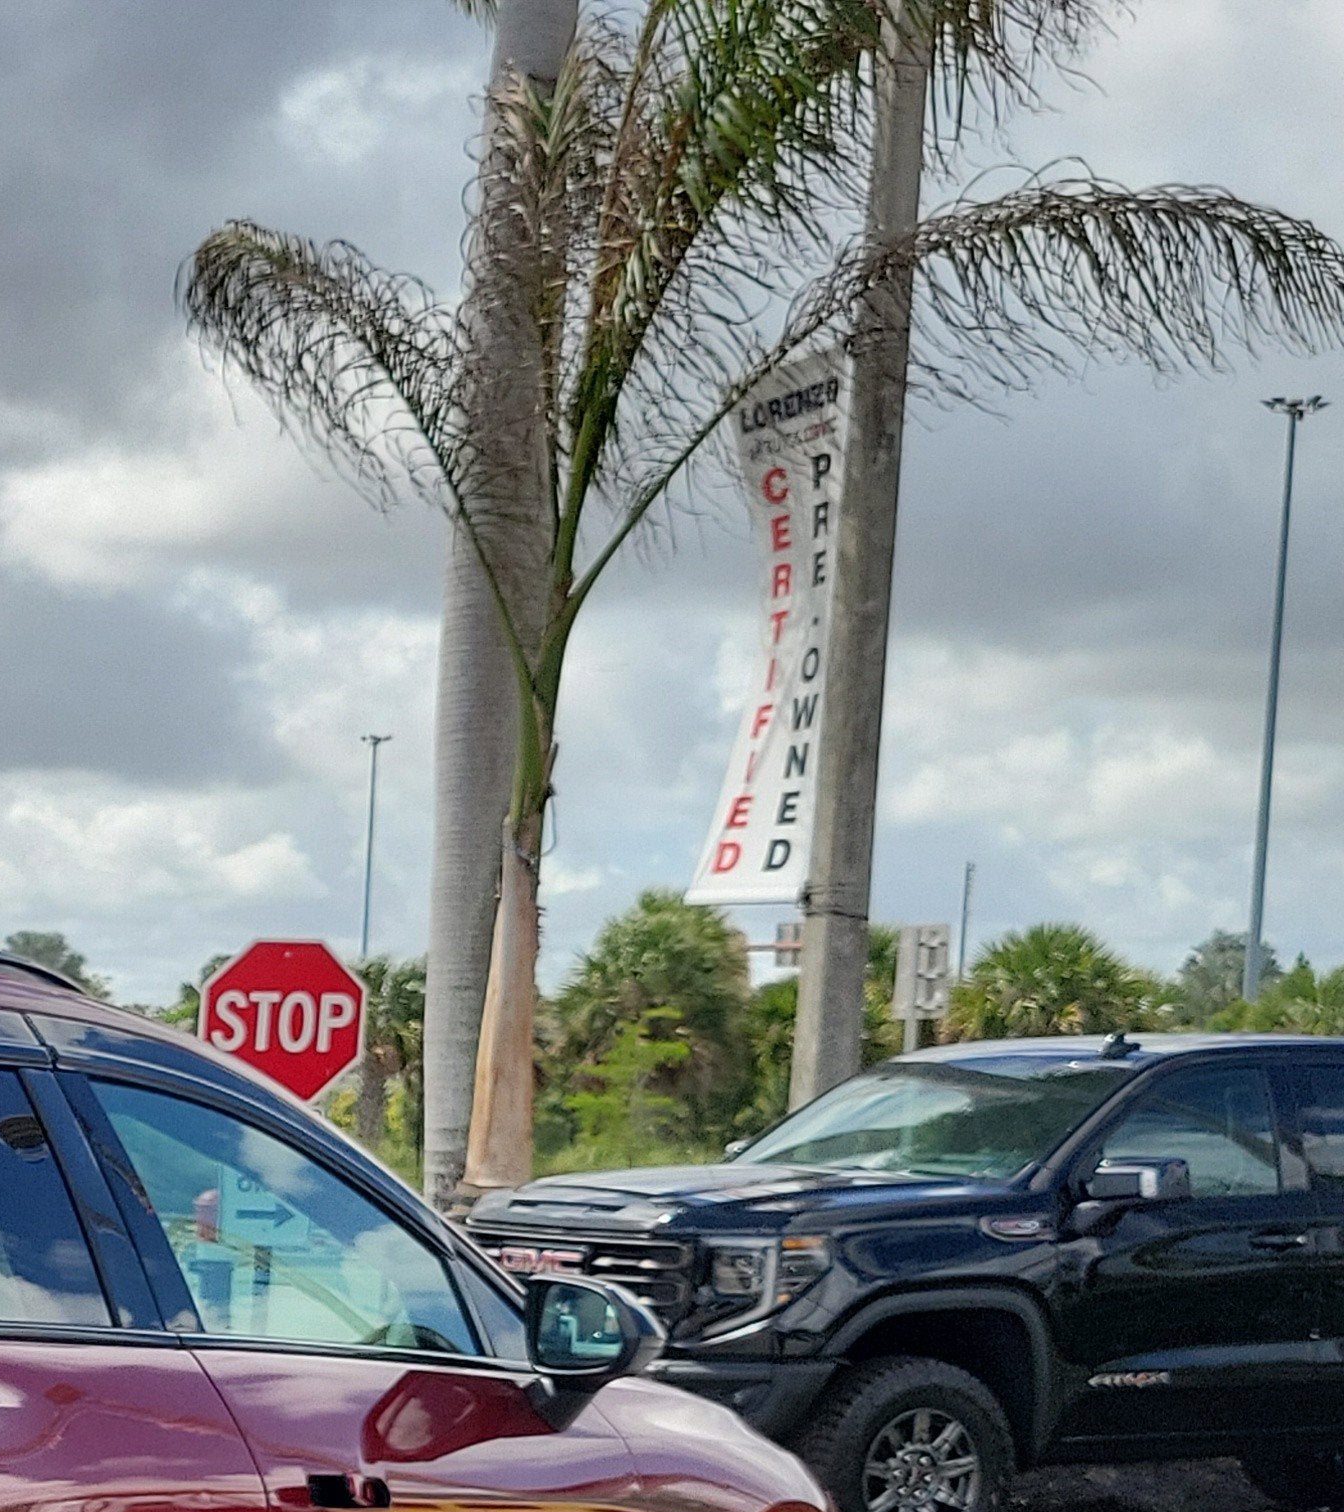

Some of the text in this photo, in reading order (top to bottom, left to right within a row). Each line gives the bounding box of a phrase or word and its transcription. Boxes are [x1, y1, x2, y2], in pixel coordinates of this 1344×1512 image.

[714, 466, 793, 874] CERTIFIED
[211, 989, 356, 1053] STOP
[500, 1247, 583, 1274] GMC
